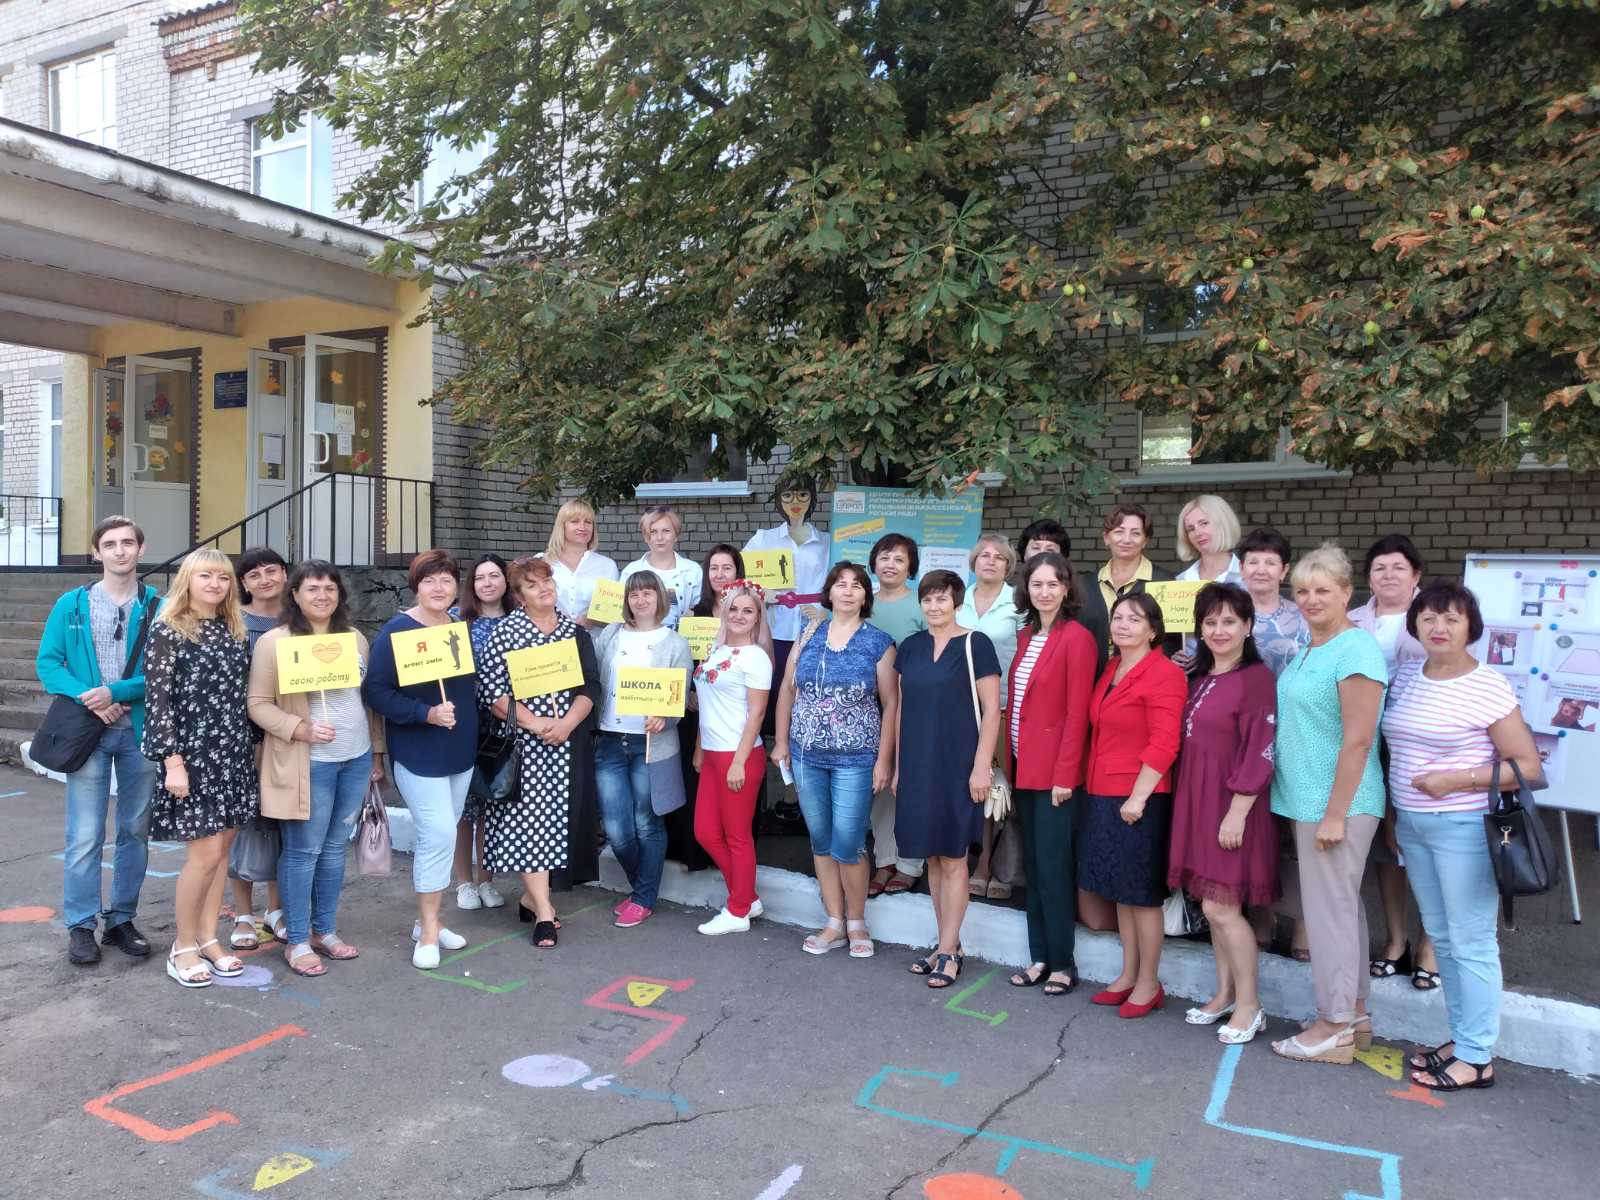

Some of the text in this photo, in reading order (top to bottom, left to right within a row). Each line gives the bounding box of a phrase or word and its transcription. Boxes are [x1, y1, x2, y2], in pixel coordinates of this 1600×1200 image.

[756, 560, 764, 569] Я
[416, 640, 428, 653] Я
[289, 672, 351, 687] свою роботу
[620, 680, 662, 690] ШКОЛА
